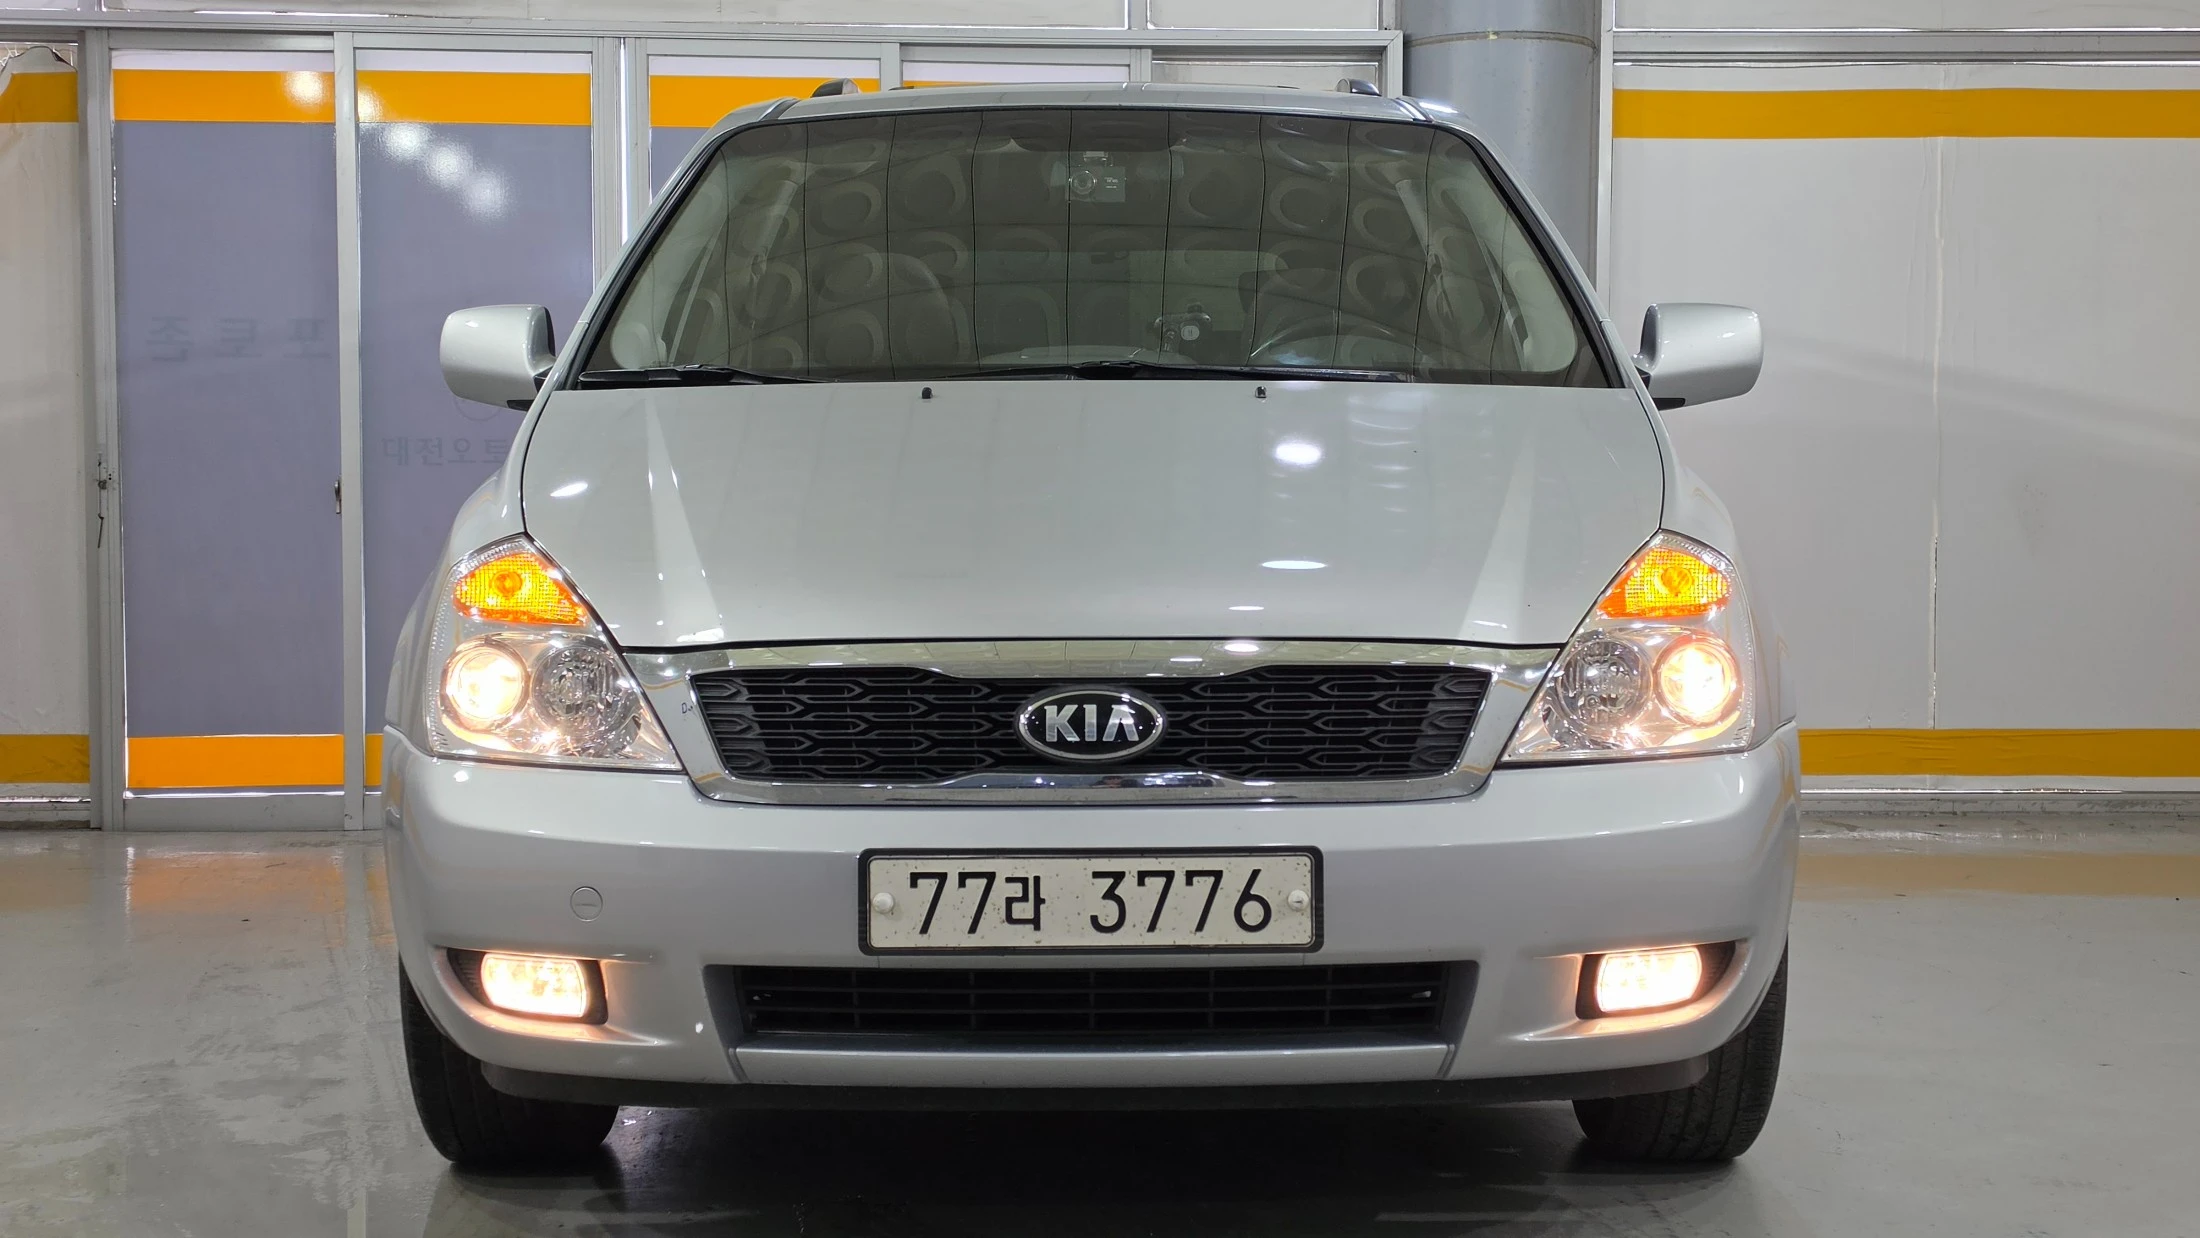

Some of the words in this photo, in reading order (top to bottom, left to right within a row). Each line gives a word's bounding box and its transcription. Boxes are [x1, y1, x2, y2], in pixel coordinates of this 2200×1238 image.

[1044, 704, 1139, 742] KIA
[909, 870, 1046, 935] 77라
[1089, 868, 1273, 934] 3776
